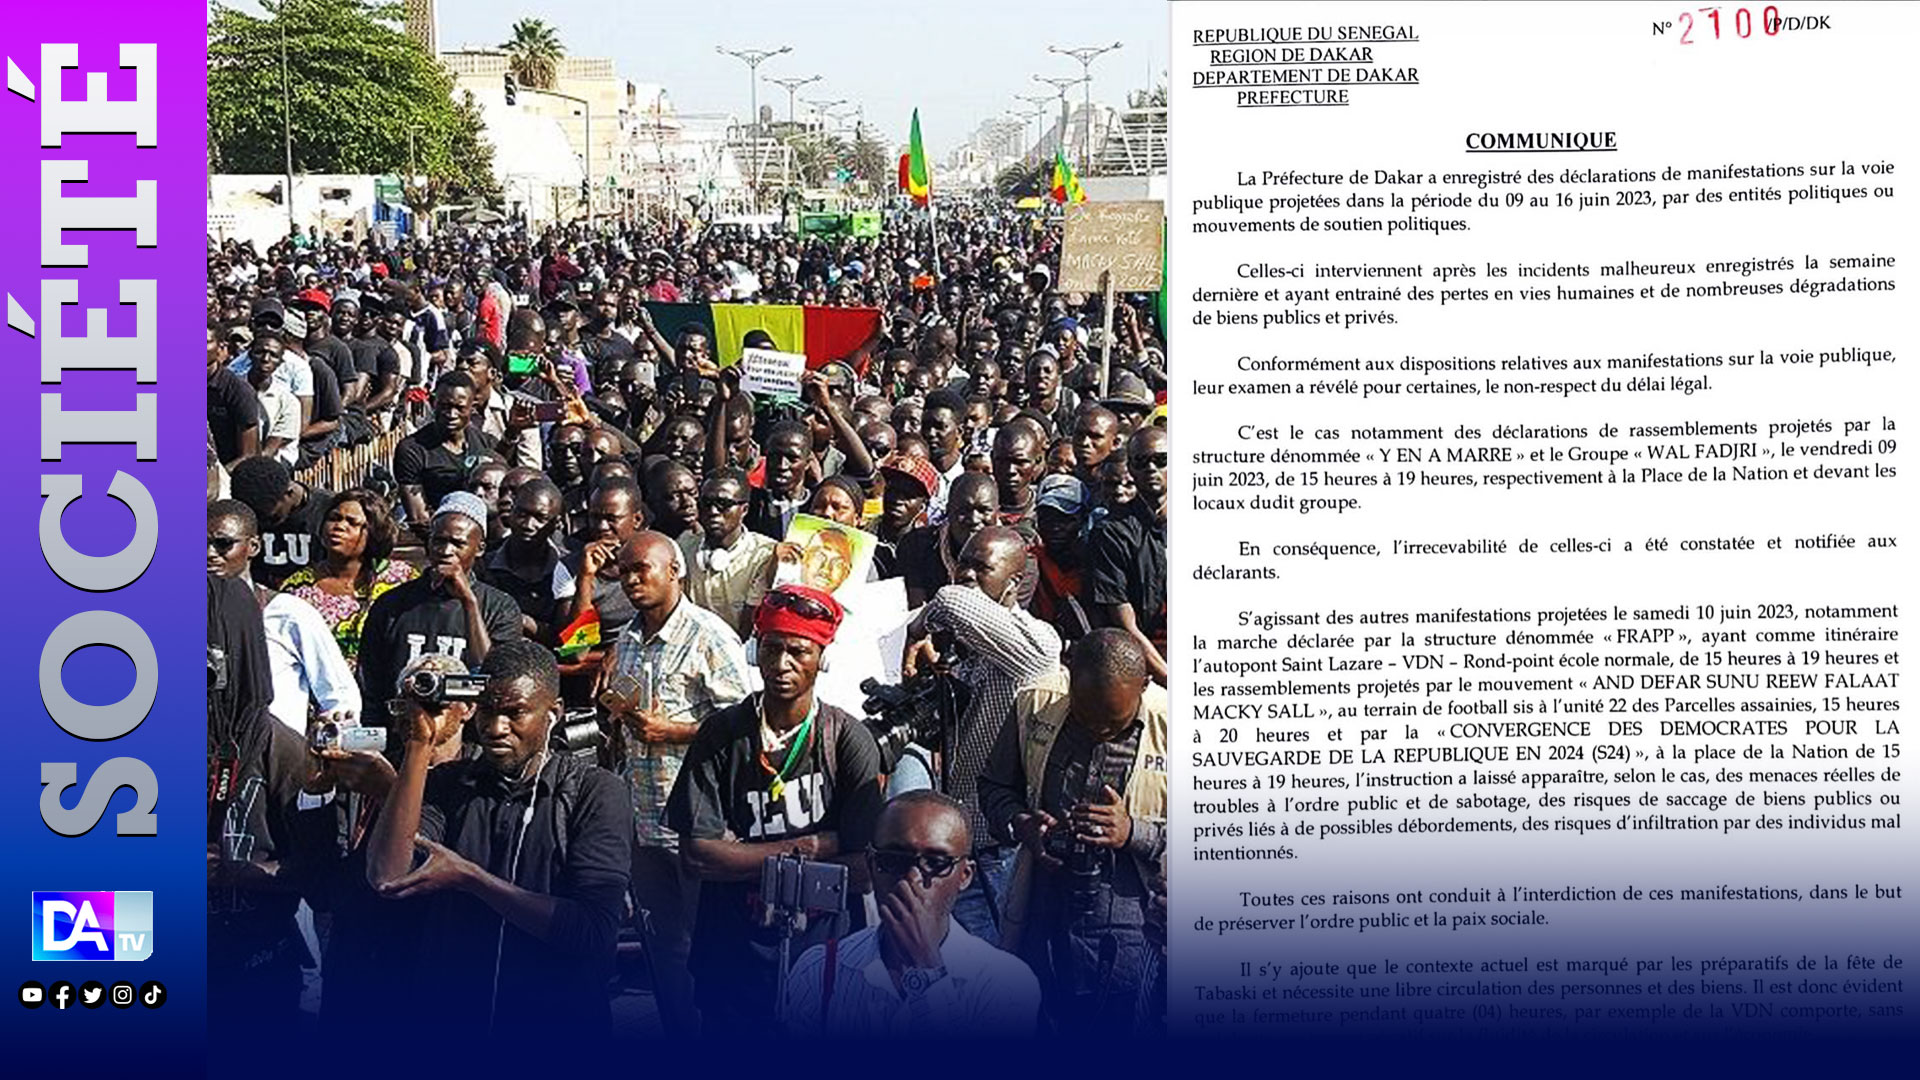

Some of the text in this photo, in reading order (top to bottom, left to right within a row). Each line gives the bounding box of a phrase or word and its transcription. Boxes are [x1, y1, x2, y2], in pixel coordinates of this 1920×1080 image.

[1193, 25, 1419, 44] REPUBLIQUE DU SENEGAL
[1210, 47, 1373, 64] REGION DE DAKAR
[1193, 67, 1419, 86] DEPARTEMENT DE DAKAR
[1237, 89, 1350, 105] PREFECTURE
[1466, 131, 1617, 150] COMMUNIQUE
[1237, 159, 1895, 190] La Préfecture de Dakar a enregistré des déclarations de manifestations sur la voie
[1192, 215, 1471, 236] mouvements de soutien politiques.
[1237, 253, 1896, 283] Celles-ci interviennent après les incidents malheureux enregistrés la semaine
[1237, 346, 1896, 376] Conformément aux dispositions relatives aux manifestations sur la voie publique,
[1193, 374, 1712, 399] leur examen a révélé pour certaines, le non-respect du délai légal.
[1290, 424, 1304, 440] le
[1314, 428, 1340, 440] cas
[1351, 426, 1444, 440] notamment
[1454, 424, 1482, 440] des
[1492, 423, 1588, 440] déclarations
[1598, 422, 1619, 438] de
[1629, 420, 1758, 438] rassemblements
[1768, 418, 1833, 439] projetés
[1843, 420, 1871, 437] par
[1882, 415, 1896, 431] la
[1193, 494, 1362, 515] locaux dudit groupe.
[262, 532, 312, 565] LU
[1238, 540, 1261, 557] En
[1272, 541, 1381, 561] conséquence,
[1518, 538, 1539, 554] de
[1549, 537, 1612, 553] celles-ci
[1623, 541, 1633, 552] a
[1644, 537, 1669, 552] été
[1680, 535, 1755, 551] constatée
[1766, 536, 1782, 550] et
[1794, 533, 1856, 549] notifiée
[1867, 537, 1897, 548] aux
[1192, 564, 1280, 580] déclarants.
[1325, 609, 1354, 625] des
[1359, 610, 1409, 625] autres
[1415, 607, 1532, 624] manifestations
[1537, 606, 1608, 627] projetées
[1613, 605, 1628, 621] le
[1632, 604, 1690, 621] samedi
[1696, 604, 1715, 620] 10
[1719, 604, 1752, 625] juin
[1757, 603, 1799, 621] 2023,
[1805, 604, 1899, 619] notamment
[1144, 754, 1168, 771] PR
[747, 772, 826, 838] LU
[1193, 797, 1259, 814] troubles
[1267, 798, 1276, 813] à
[1347, 794, 1398, 817] public
[1405, 796, 1421, 810] et
[1428, 793, 1449, 810] de
[1456, 792, 1531, 813] sabotage,
[1538, 791, 1566, 808] des
[1573, 792, 1631, 812] risques
[1638, 790, 1659, 807] de
[1666, 795, 1728, 812] saccage
[1735, 790, 1756, 807] de
[1763, 790, 1806, 807] biens
[1814, 790, 1873, 811] publics
[1879, 794, 1901, 806] ou
[1193, 845, 1298, 861] intentionnés.
[1239, 891, 1295, 907] Toutes
[1300, 894, 1326, 906] ces
[1332, 889, 1390, 906] raisons
[1396, 890, 1423, 904] ont
[1428, 887, 1492, 904] conduit
[1497, 887, 1506, 902] à
[1622, 884, 1643, 901] de
[1648, 889, 1674, 901] ces
[1680, 884, 1803, 902] manifestations,
[1809, 883, 1848, 900] dans
[1855, 883, 1869, 900] le
[1874, 883, 1902, 899] but
[1193, 915, 1214, 931] de
[1218, 916, 1296, 936] préserver
[1359, 912, 1410, 933] public
[1413, 913, 1429, 927] et
[1433, 911, 1447, 927] la
[1452, 911, 1487, 932] paix
[1490, 909, 1549, 926] sociale.
